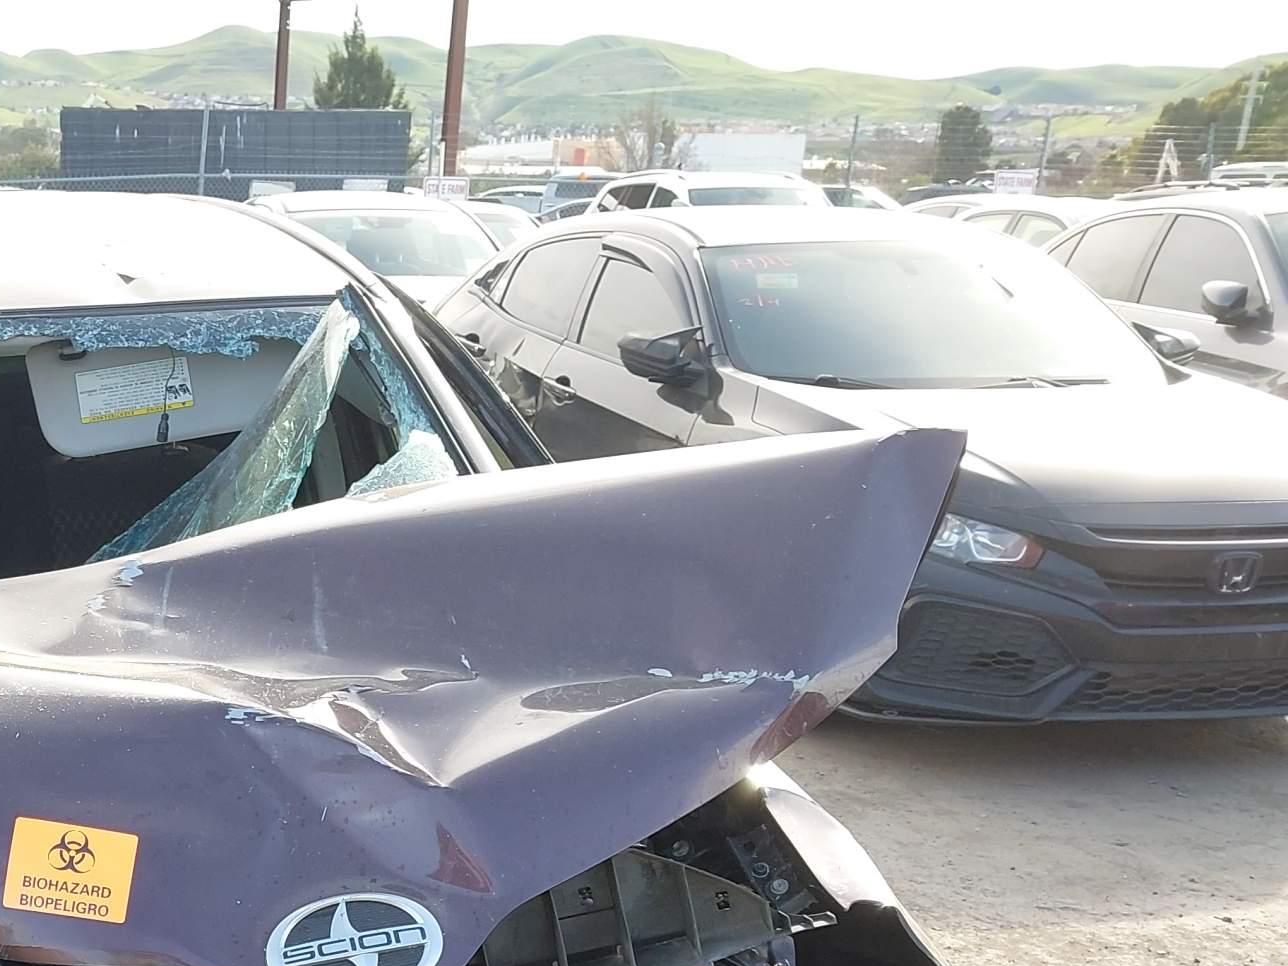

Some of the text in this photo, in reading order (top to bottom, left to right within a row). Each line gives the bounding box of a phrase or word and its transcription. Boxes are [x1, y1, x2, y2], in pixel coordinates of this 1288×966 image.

[427, 183, 446, 194] STAE
[22, 875, 112, 899] BIOHAZARD
[19, 893, 110, 917] BIOPELIGRO
